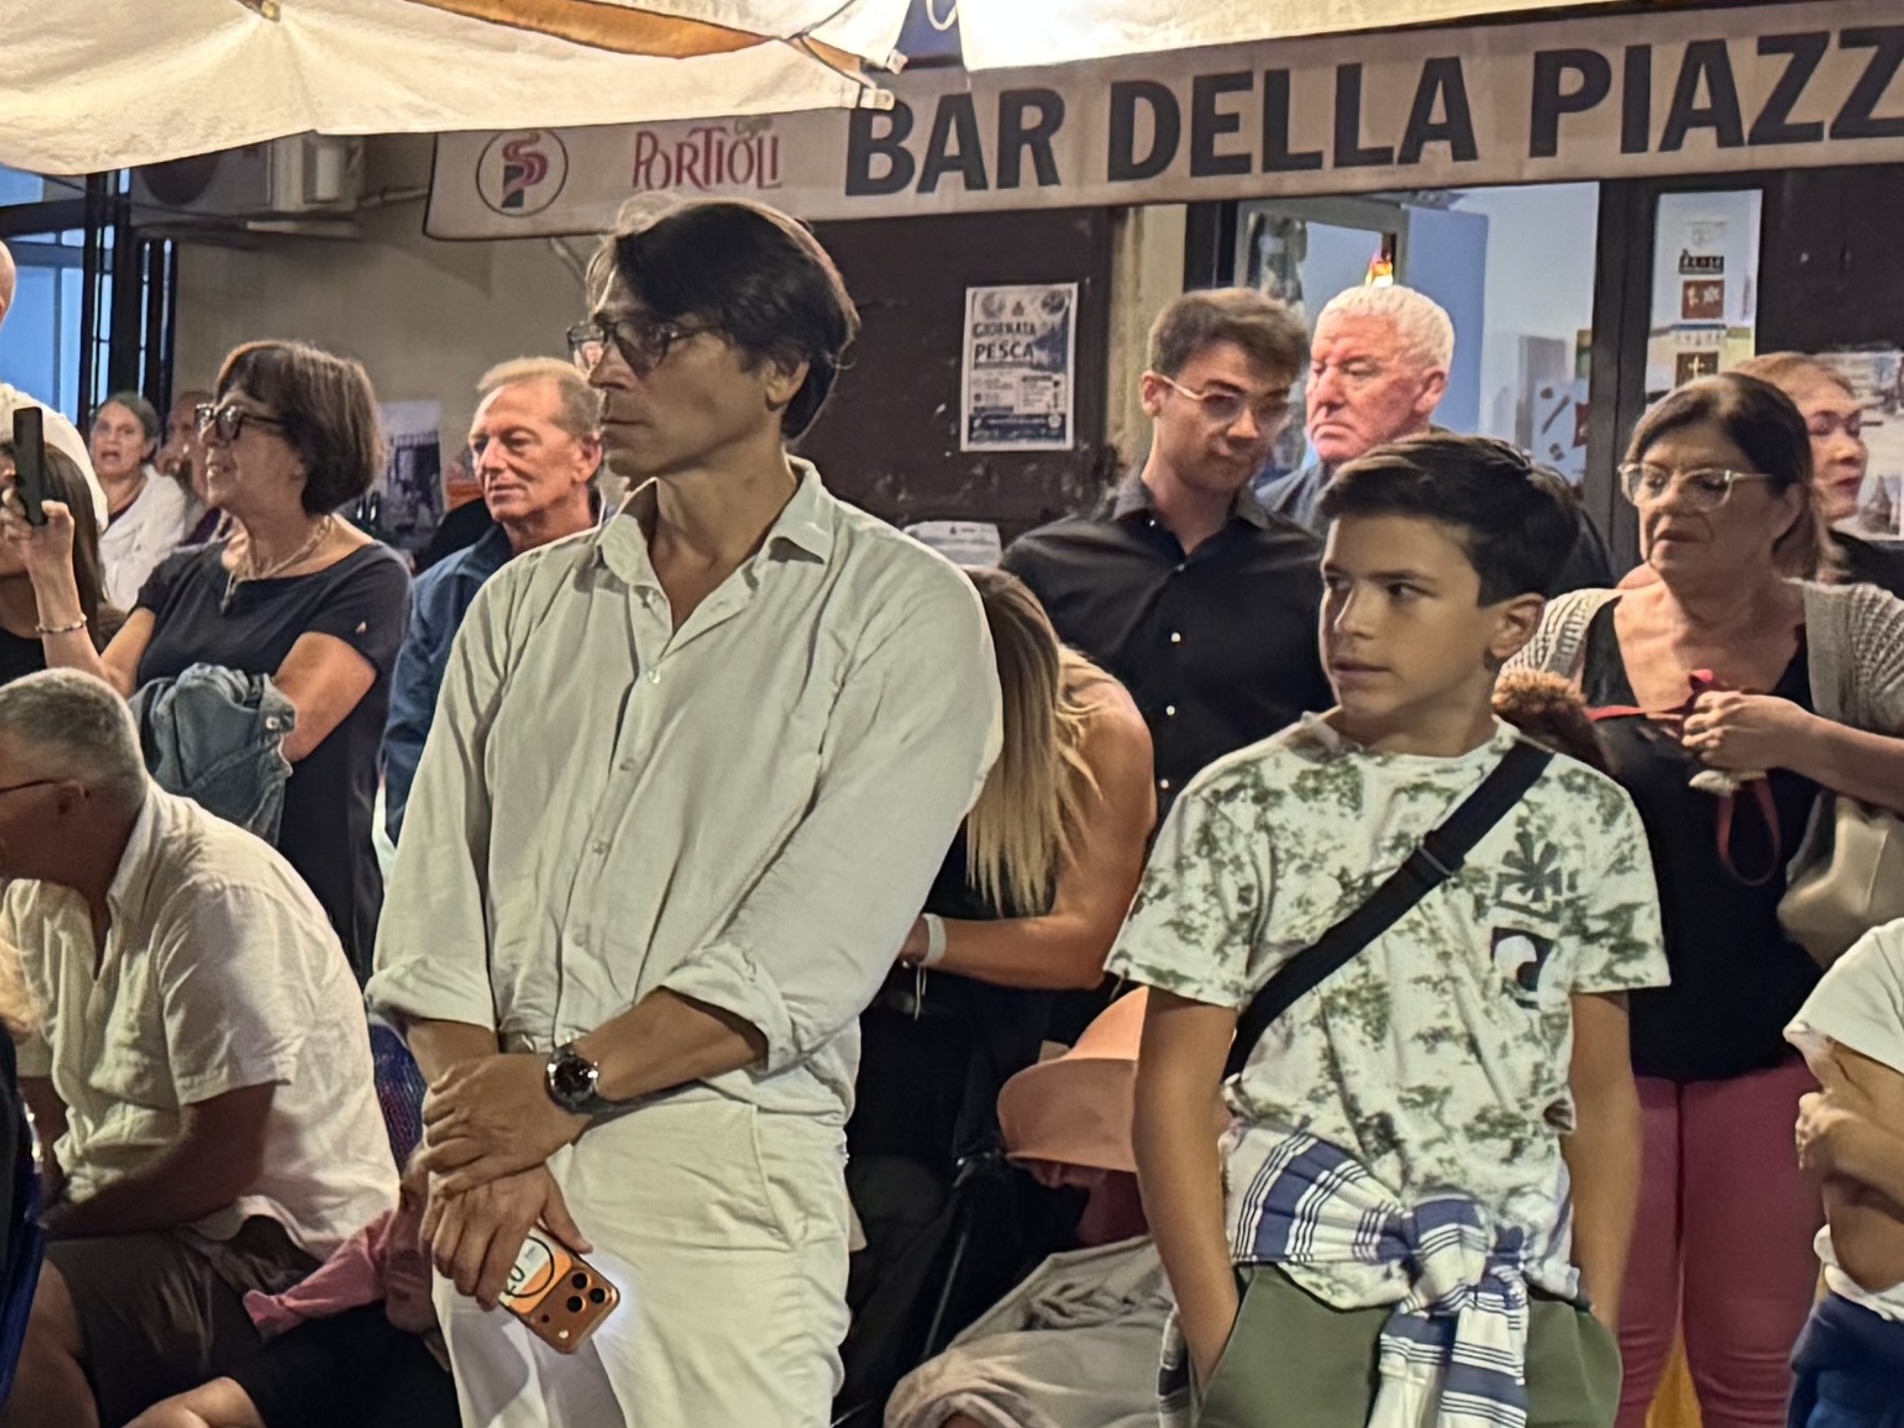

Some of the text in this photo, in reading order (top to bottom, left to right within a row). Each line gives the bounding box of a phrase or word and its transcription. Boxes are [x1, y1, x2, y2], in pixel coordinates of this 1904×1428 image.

[845, 25, 1904, 197] BAR DELLA PIAZZ
[631, 125, 783, 192] PORTIOLI
[974, 340, 1035, 360] PESCA
